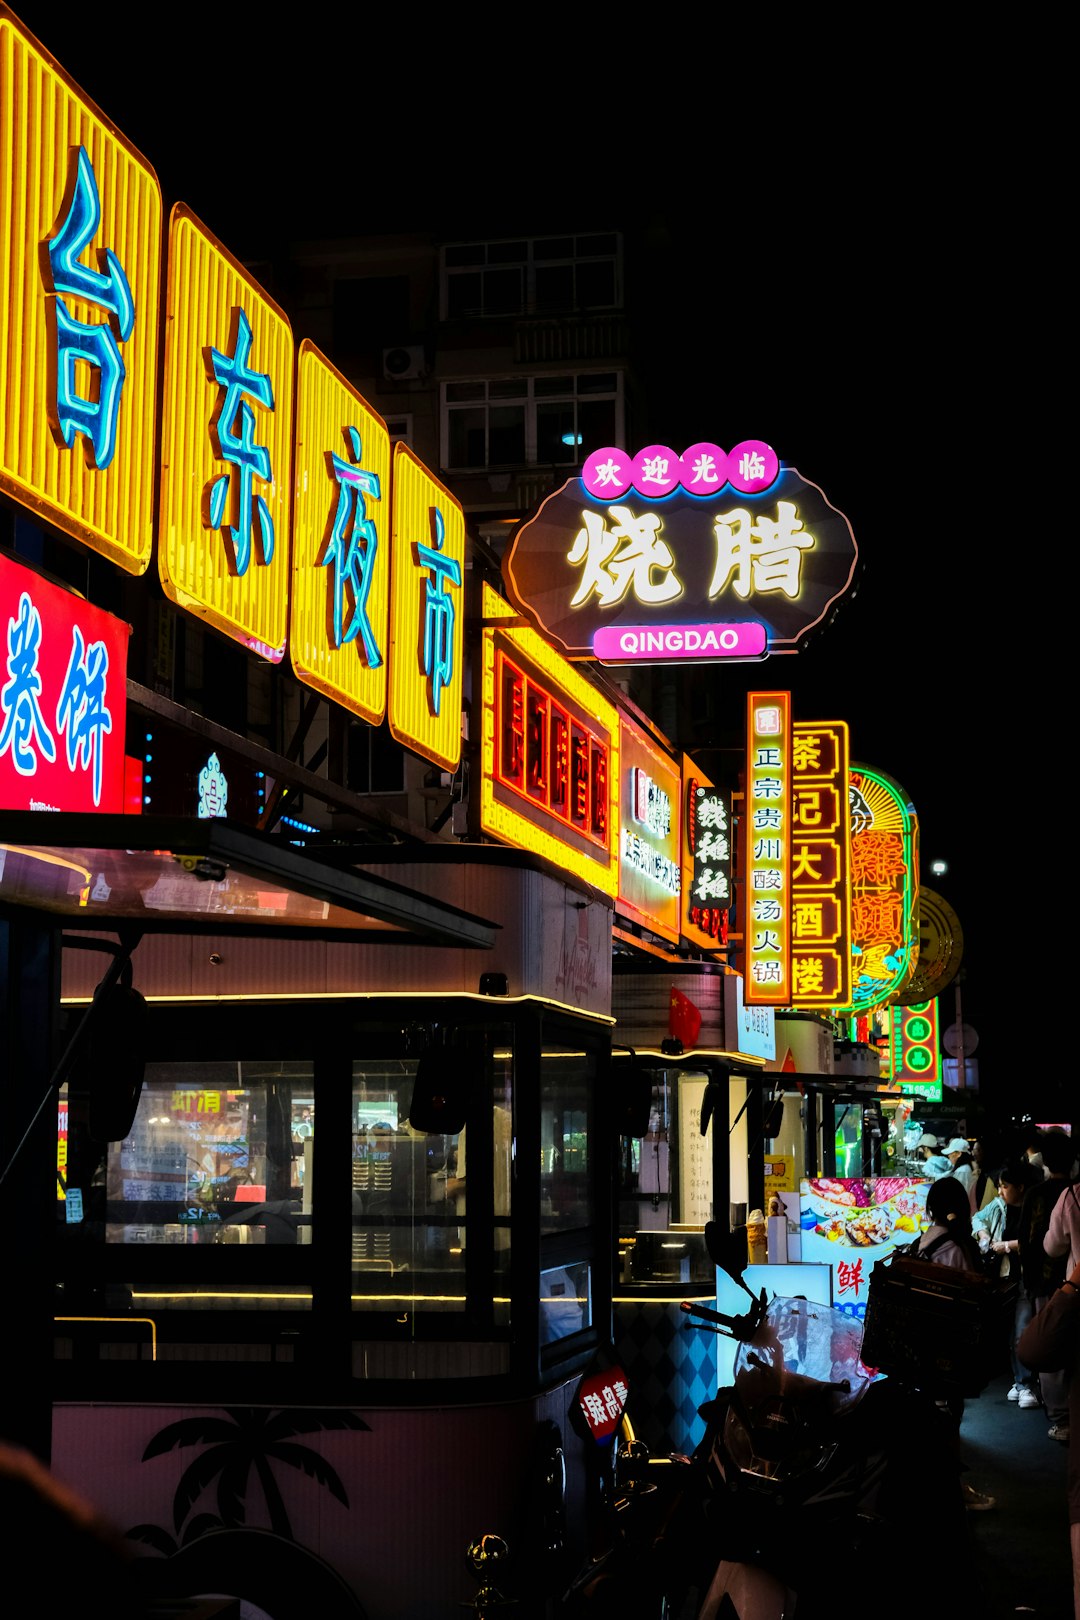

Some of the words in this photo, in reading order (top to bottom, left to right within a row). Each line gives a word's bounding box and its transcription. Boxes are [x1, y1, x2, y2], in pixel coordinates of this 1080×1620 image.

[40, 145, 463, 717] 台东夜市
[593, 452, 766, 487] 欢迎光临
[567, 501, 816, 607] 烧腊
[0, 592, 112, 807] 卷饼
[620, 629, 739, 654] QINGDAO
[753, 748, 783, 984] 正宗贵州酸汤火锅
[793, 736, 823, 994] 茶记大酒楼
[837, 1258, 865, 1296] 鲜
